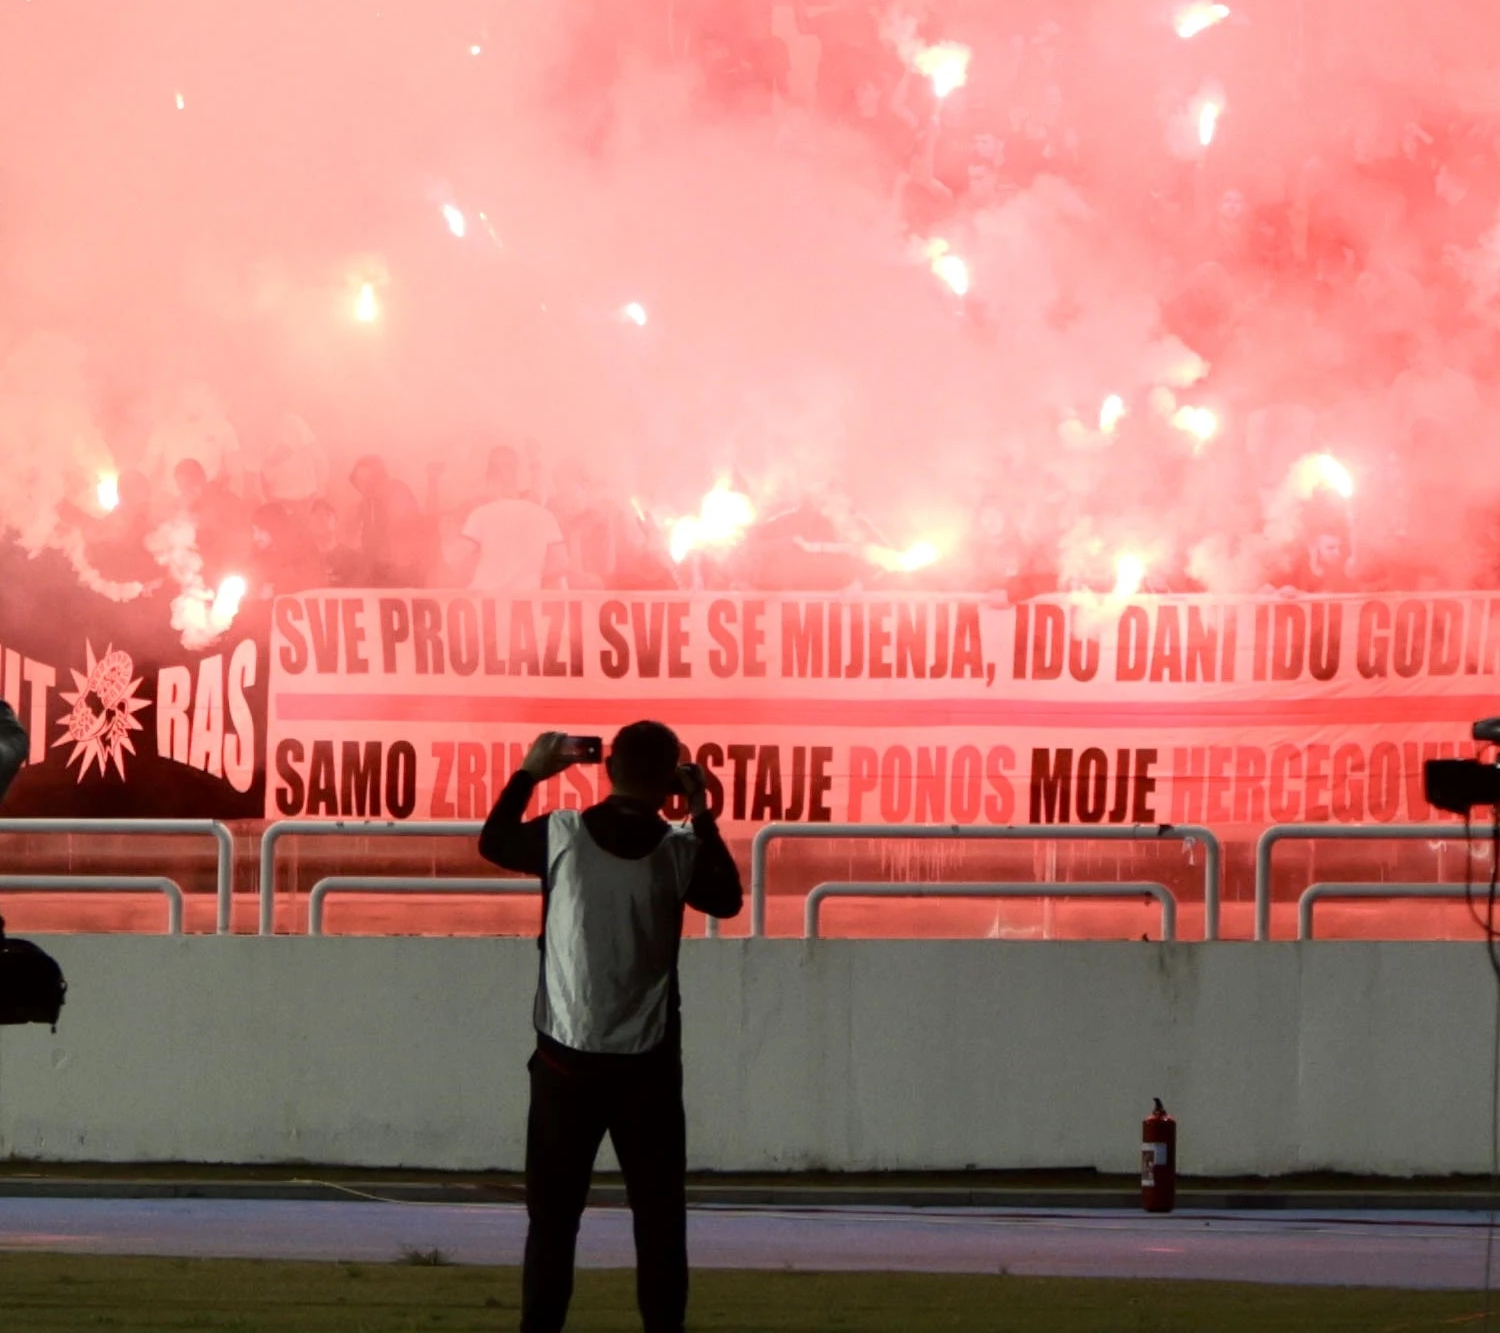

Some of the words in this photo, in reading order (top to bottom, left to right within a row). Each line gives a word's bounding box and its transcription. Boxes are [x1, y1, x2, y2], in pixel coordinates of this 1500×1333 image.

[277, 596, 365, 675] SVE
[380, 597, 584, 678] PROLAZI
[599, 599, 692, 680] SVE
[708, 599, 769, 679] SE
[780, 600, 996, 688] MIJENJA,
[1115, 604, 1237, 683] DANI
[1254, 601, 1340, 682] IDU
[157, 637, 258, 794] RAS
[275, 737, 417, 820] SAMO
[847, 743, 1017, 825] PONOS
[1029, 747, 1158, 825] MOJE
